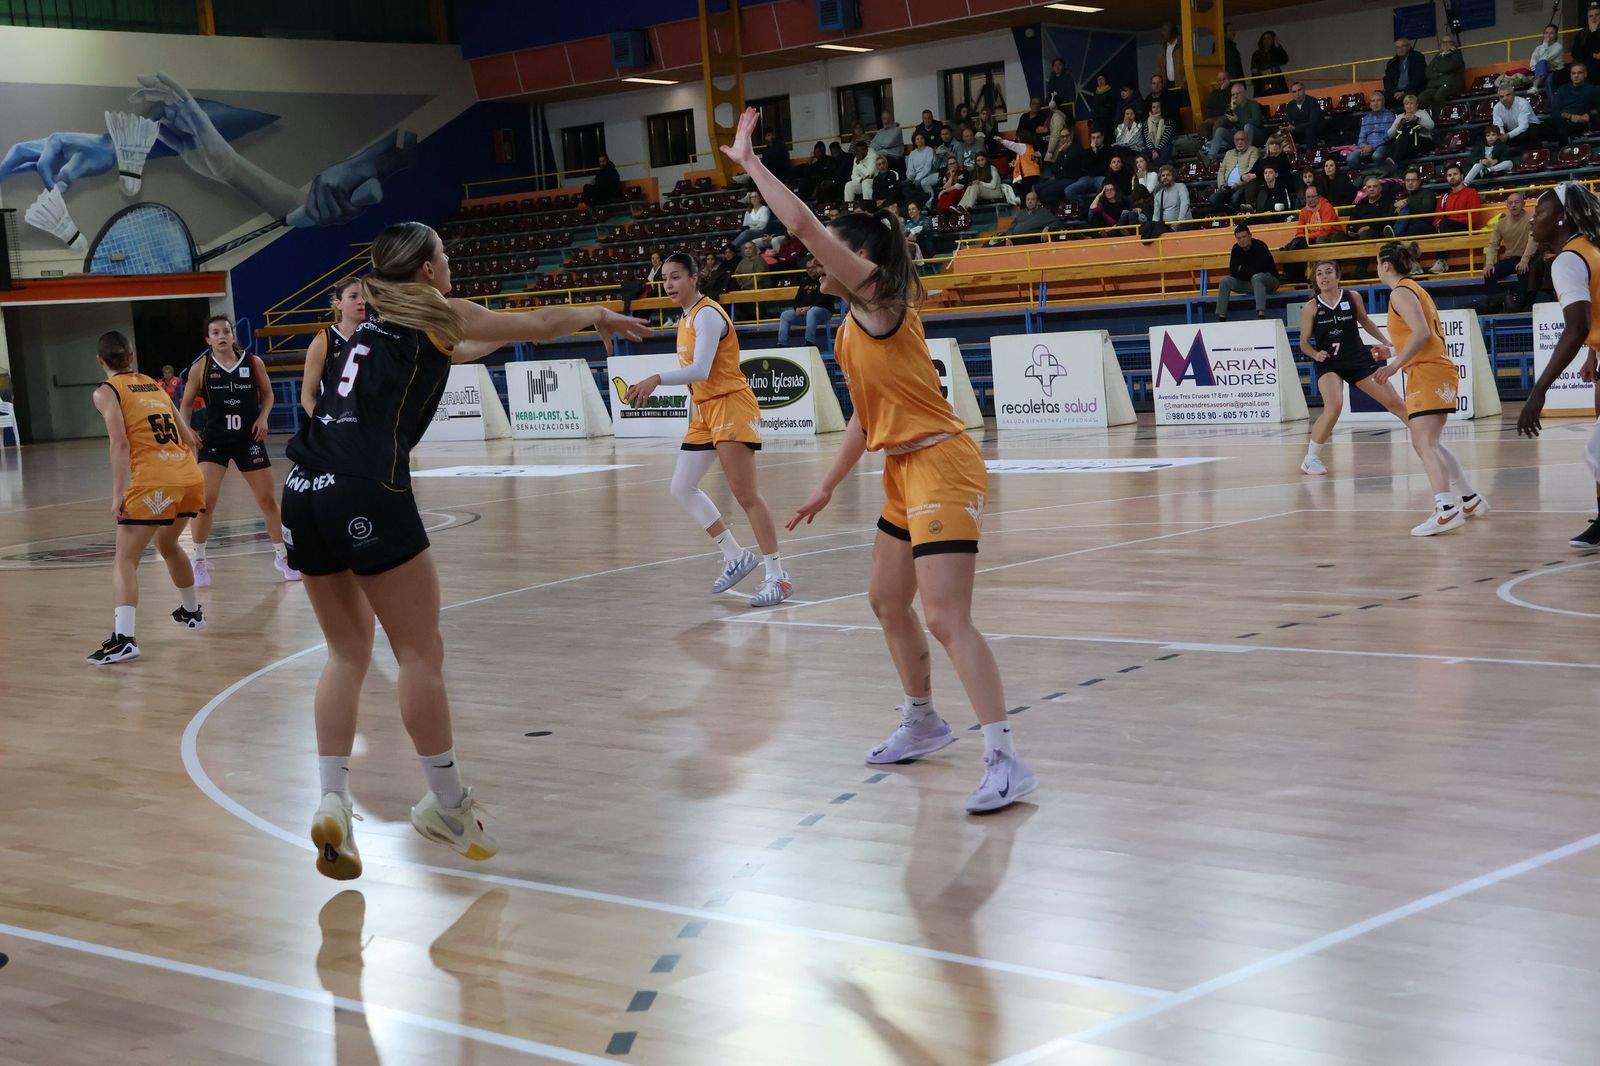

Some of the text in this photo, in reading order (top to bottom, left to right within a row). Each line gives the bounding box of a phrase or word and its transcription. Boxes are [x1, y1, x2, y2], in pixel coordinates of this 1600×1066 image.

[1532, 152, 1538, 160] 7
[1539, 322, 1566, 331] E.S. CAM
[1332, 342, 1340, 356] 7
[1447, 342, 1465, 358] MEZ
[337, 343, 371, 398] 5
[1001, 397, 1097, 414] recoletas salud
[1171, 401, 1270, 409] marianandresasesoria@gmail.com
[515, 410, 579, 422] HERBI-PLAST, S.L.
[1171, 412, 1185, 420] 980
[1186, 412, 1196, 420] 05
[1196, 411, 1206, 419] 85
[1207, 411, 1217, 419] 90
[1223, 411, 1237, 419] 605
[1238, 411, 1248, 419] 76
[1249, 410, 1258, 418] 71
[1260, 410, 1270, 418] 05
[147, 413, 180, 445] 55
[225, 414, 242, 431] 10
[516, 422, 580, 431] SEÑALIZACIONES
